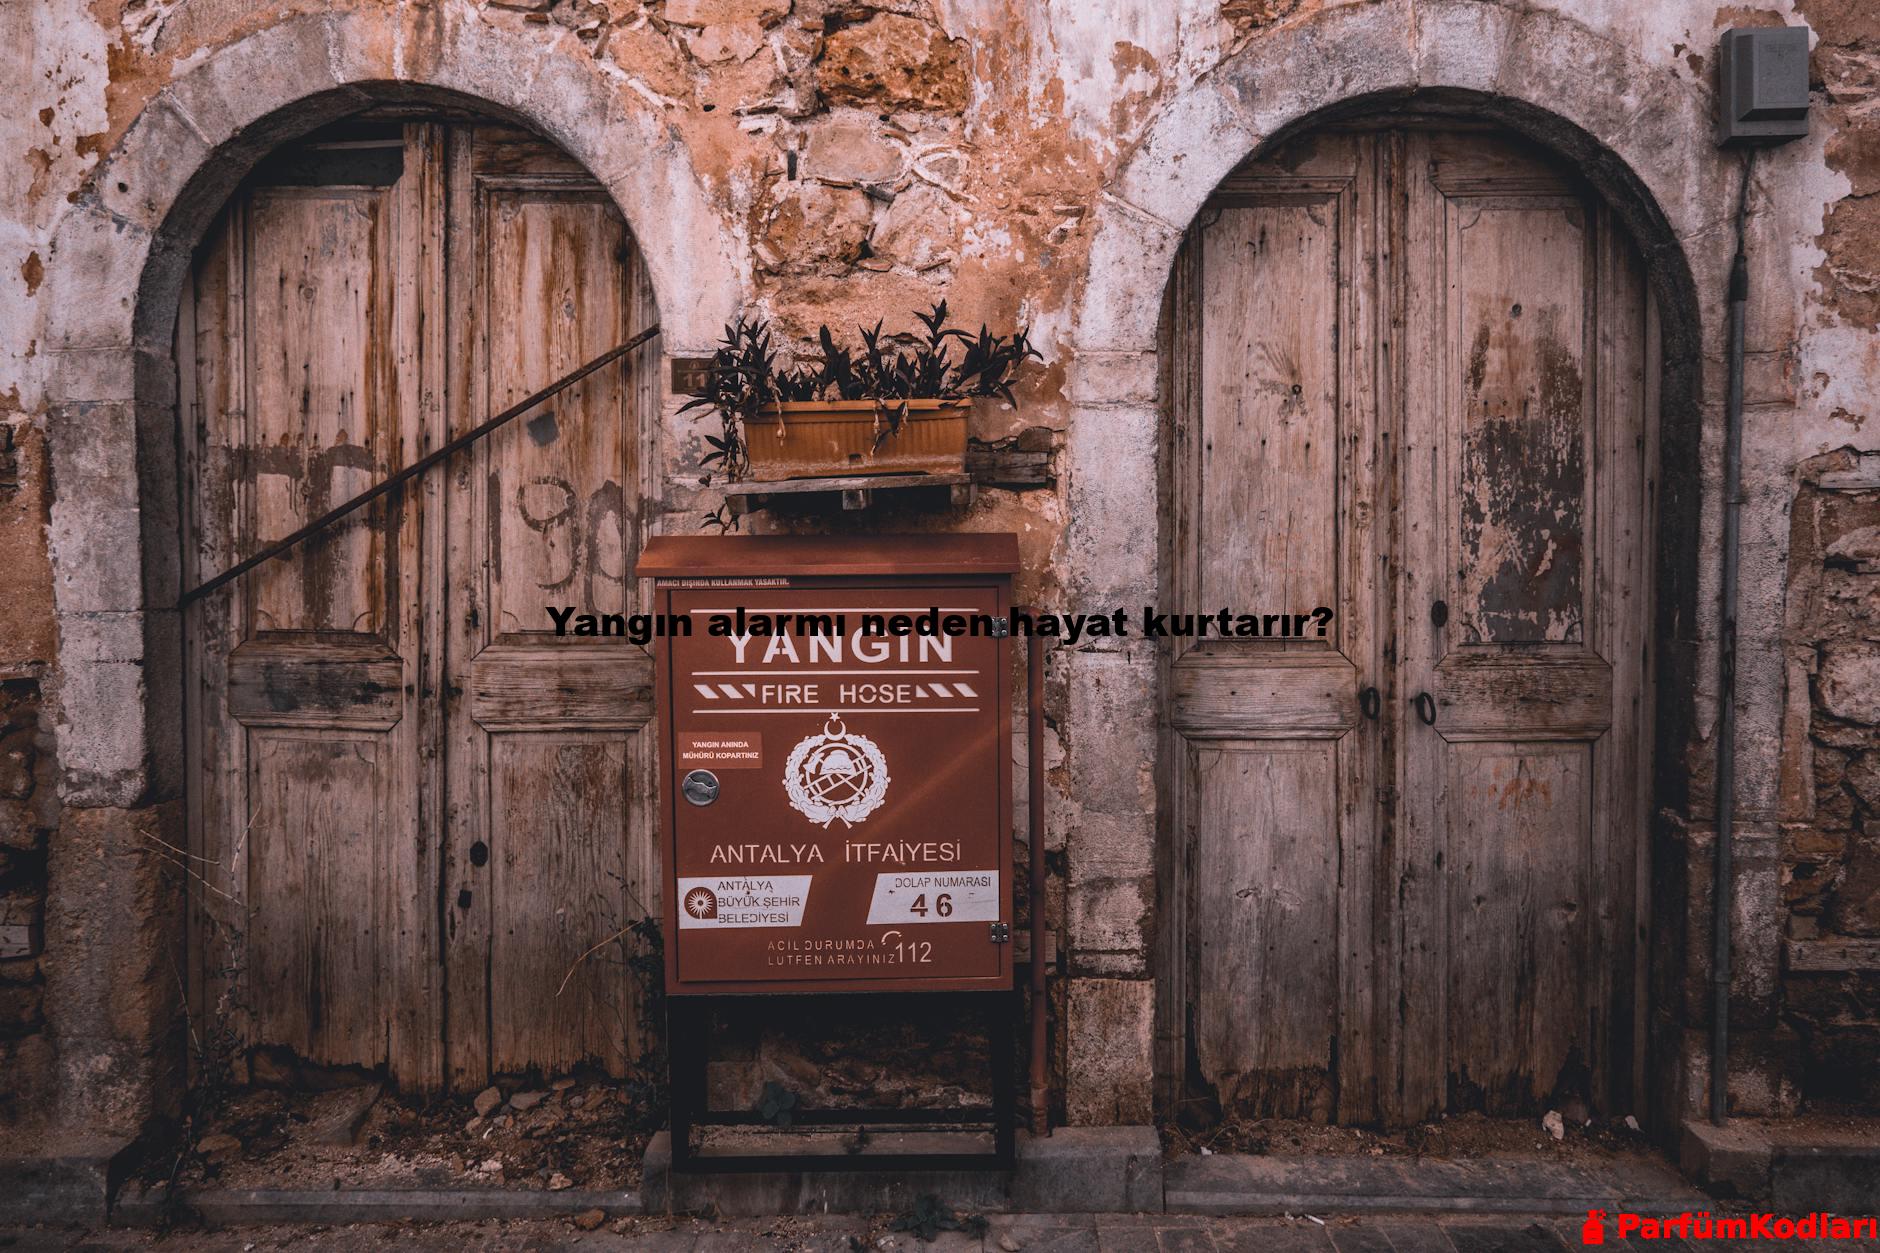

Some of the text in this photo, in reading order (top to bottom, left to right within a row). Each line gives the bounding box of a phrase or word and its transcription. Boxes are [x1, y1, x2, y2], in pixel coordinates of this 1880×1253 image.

[711, 579, 753, 587] KULLANMAK
[762, 684, 912, 704] FIRE HOSE
[682, 751, 714, 759] MÜHÜRÜ
[710, 839, 962, 863] ANTALYA İTFAİYESİ
[717, 881, 773, 891] ANTALYA
[895, 876, 991, 888] DOLAP NUMARASI
[718, 913, 789, 924] BELEDİYESİ
[804, 940, 875, 950] DURUMDA
[895, 941, 932, 963] 112
[827, 953, 895, 965] ARAYINIZ
